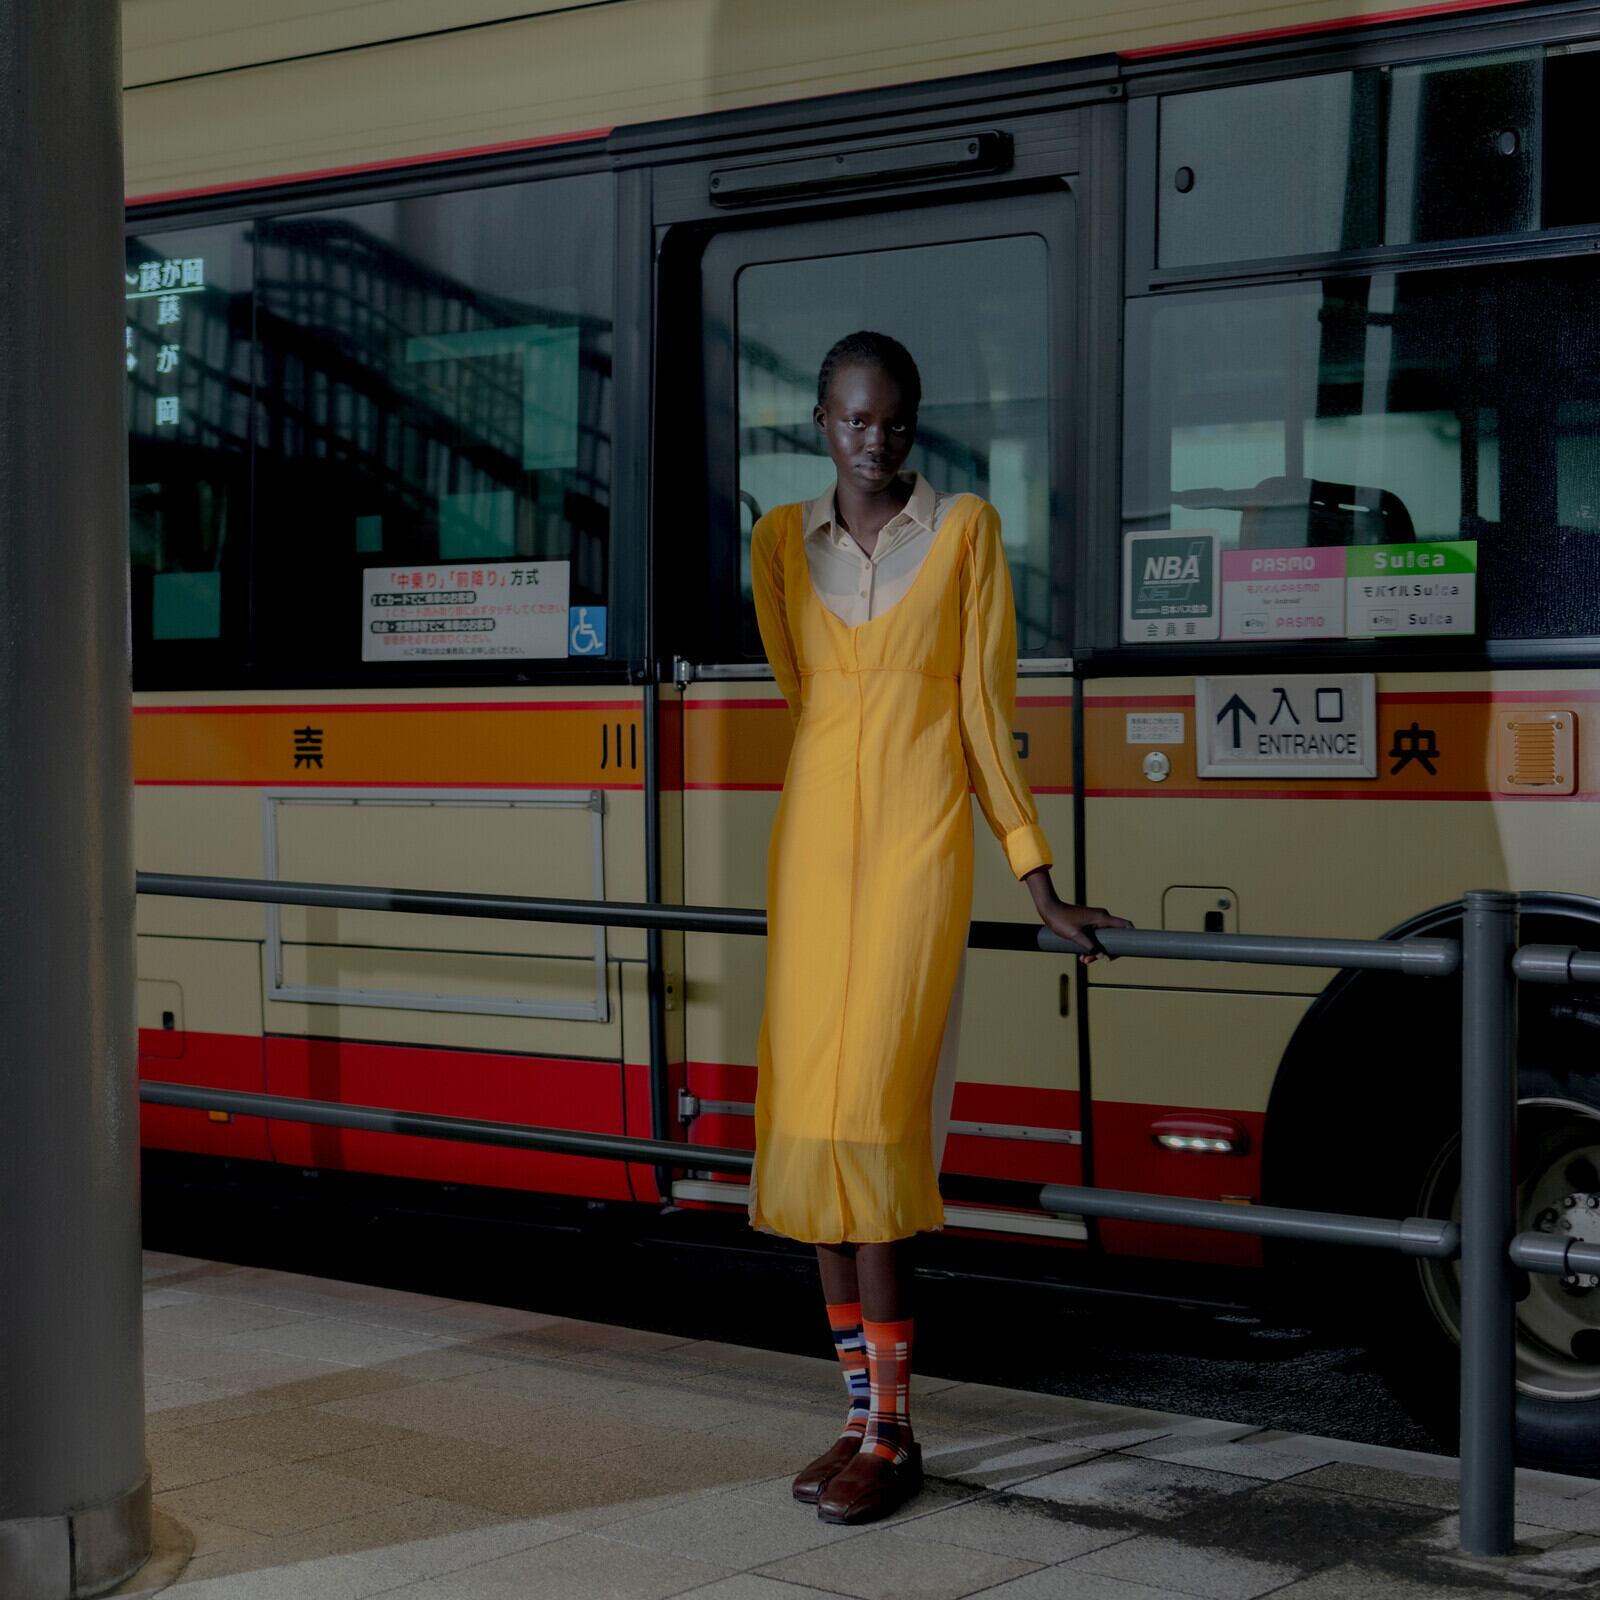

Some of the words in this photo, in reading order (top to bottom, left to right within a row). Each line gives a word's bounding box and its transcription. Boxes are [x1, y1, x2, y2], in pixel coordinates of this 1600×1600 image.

[1143, 555, 1200, 580] NBA
[1251, 556, 1316, 573] PASMO
[1374, 551, 1446, 569] Suica
[1276, 616, 1325, 628] PASMO
[1409, 613, 1453, 625] Suica
[1269, 687, 1343, 725] 入口
[600, 723, 637, 769] 川
[1388, 722, 1441, 775] 央
[1258, 734, 1357, 754] ENTRANCE
